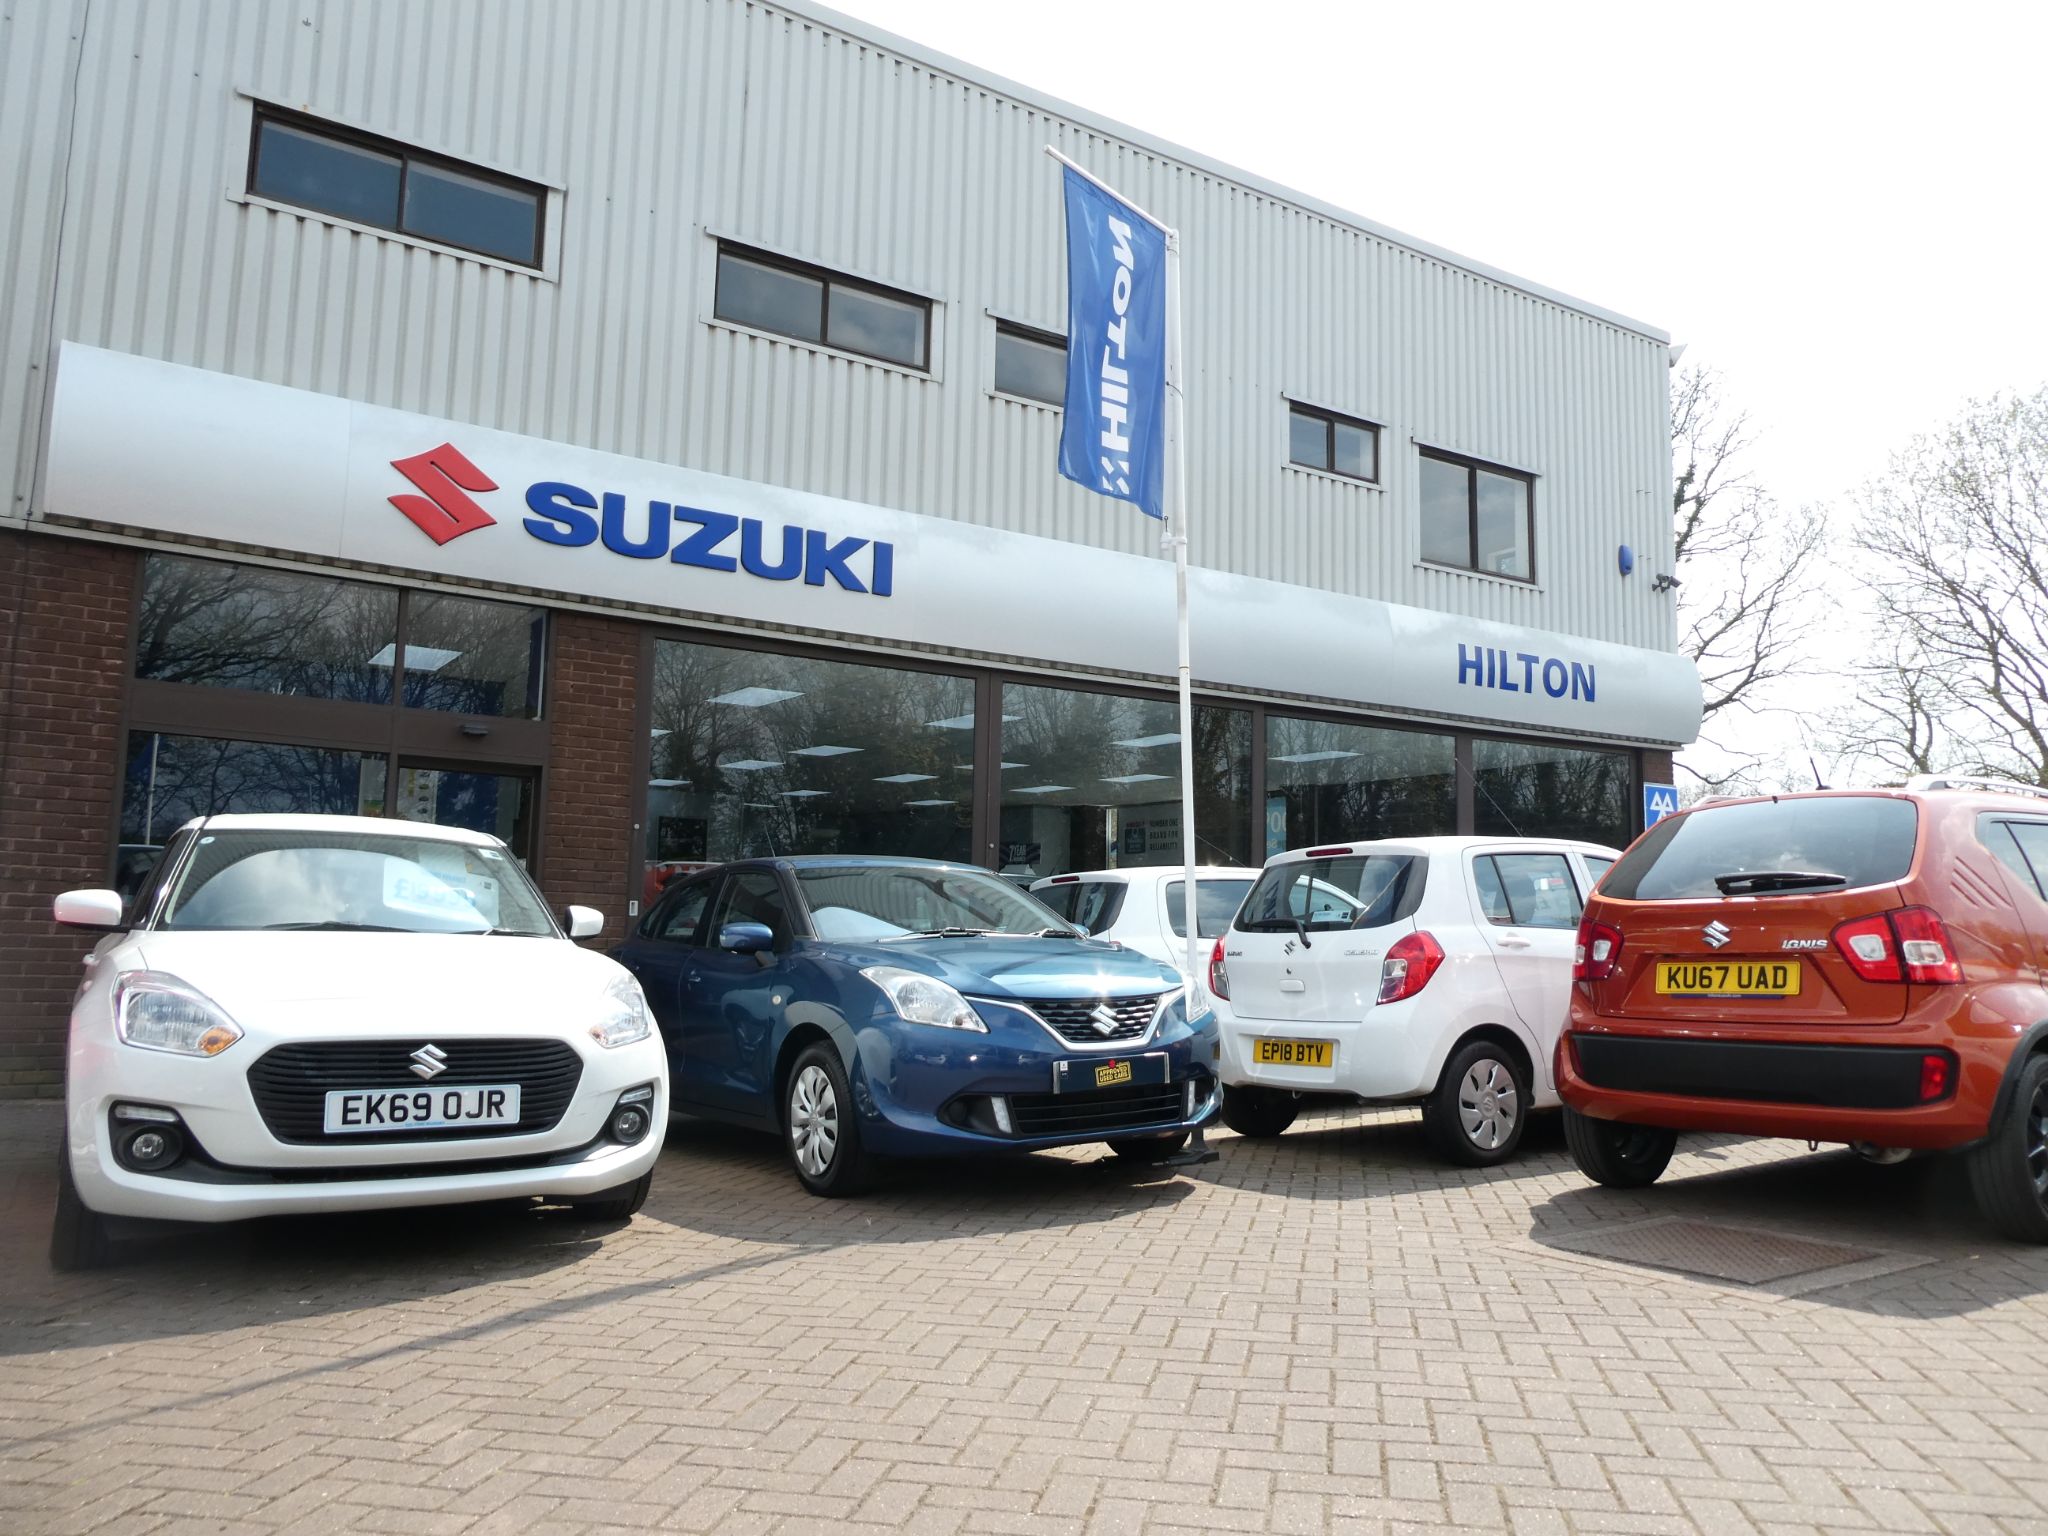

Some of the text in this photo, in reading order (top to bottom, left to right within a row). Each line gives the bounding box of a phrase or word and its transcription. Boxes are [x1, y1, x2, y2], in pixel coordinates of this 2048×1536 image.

[523, 481, 893, 597] SUZUKI
[1458, 643, 1595, 702] HILTON
[1782, 939, 1828, 949] IGNIS
[1667, 966, 1788, 990] KU67 UAD
[1262, 1042, 1324, 1062] EP18 BTV
[342, 1090, 506, 1126] EK69 OJR
